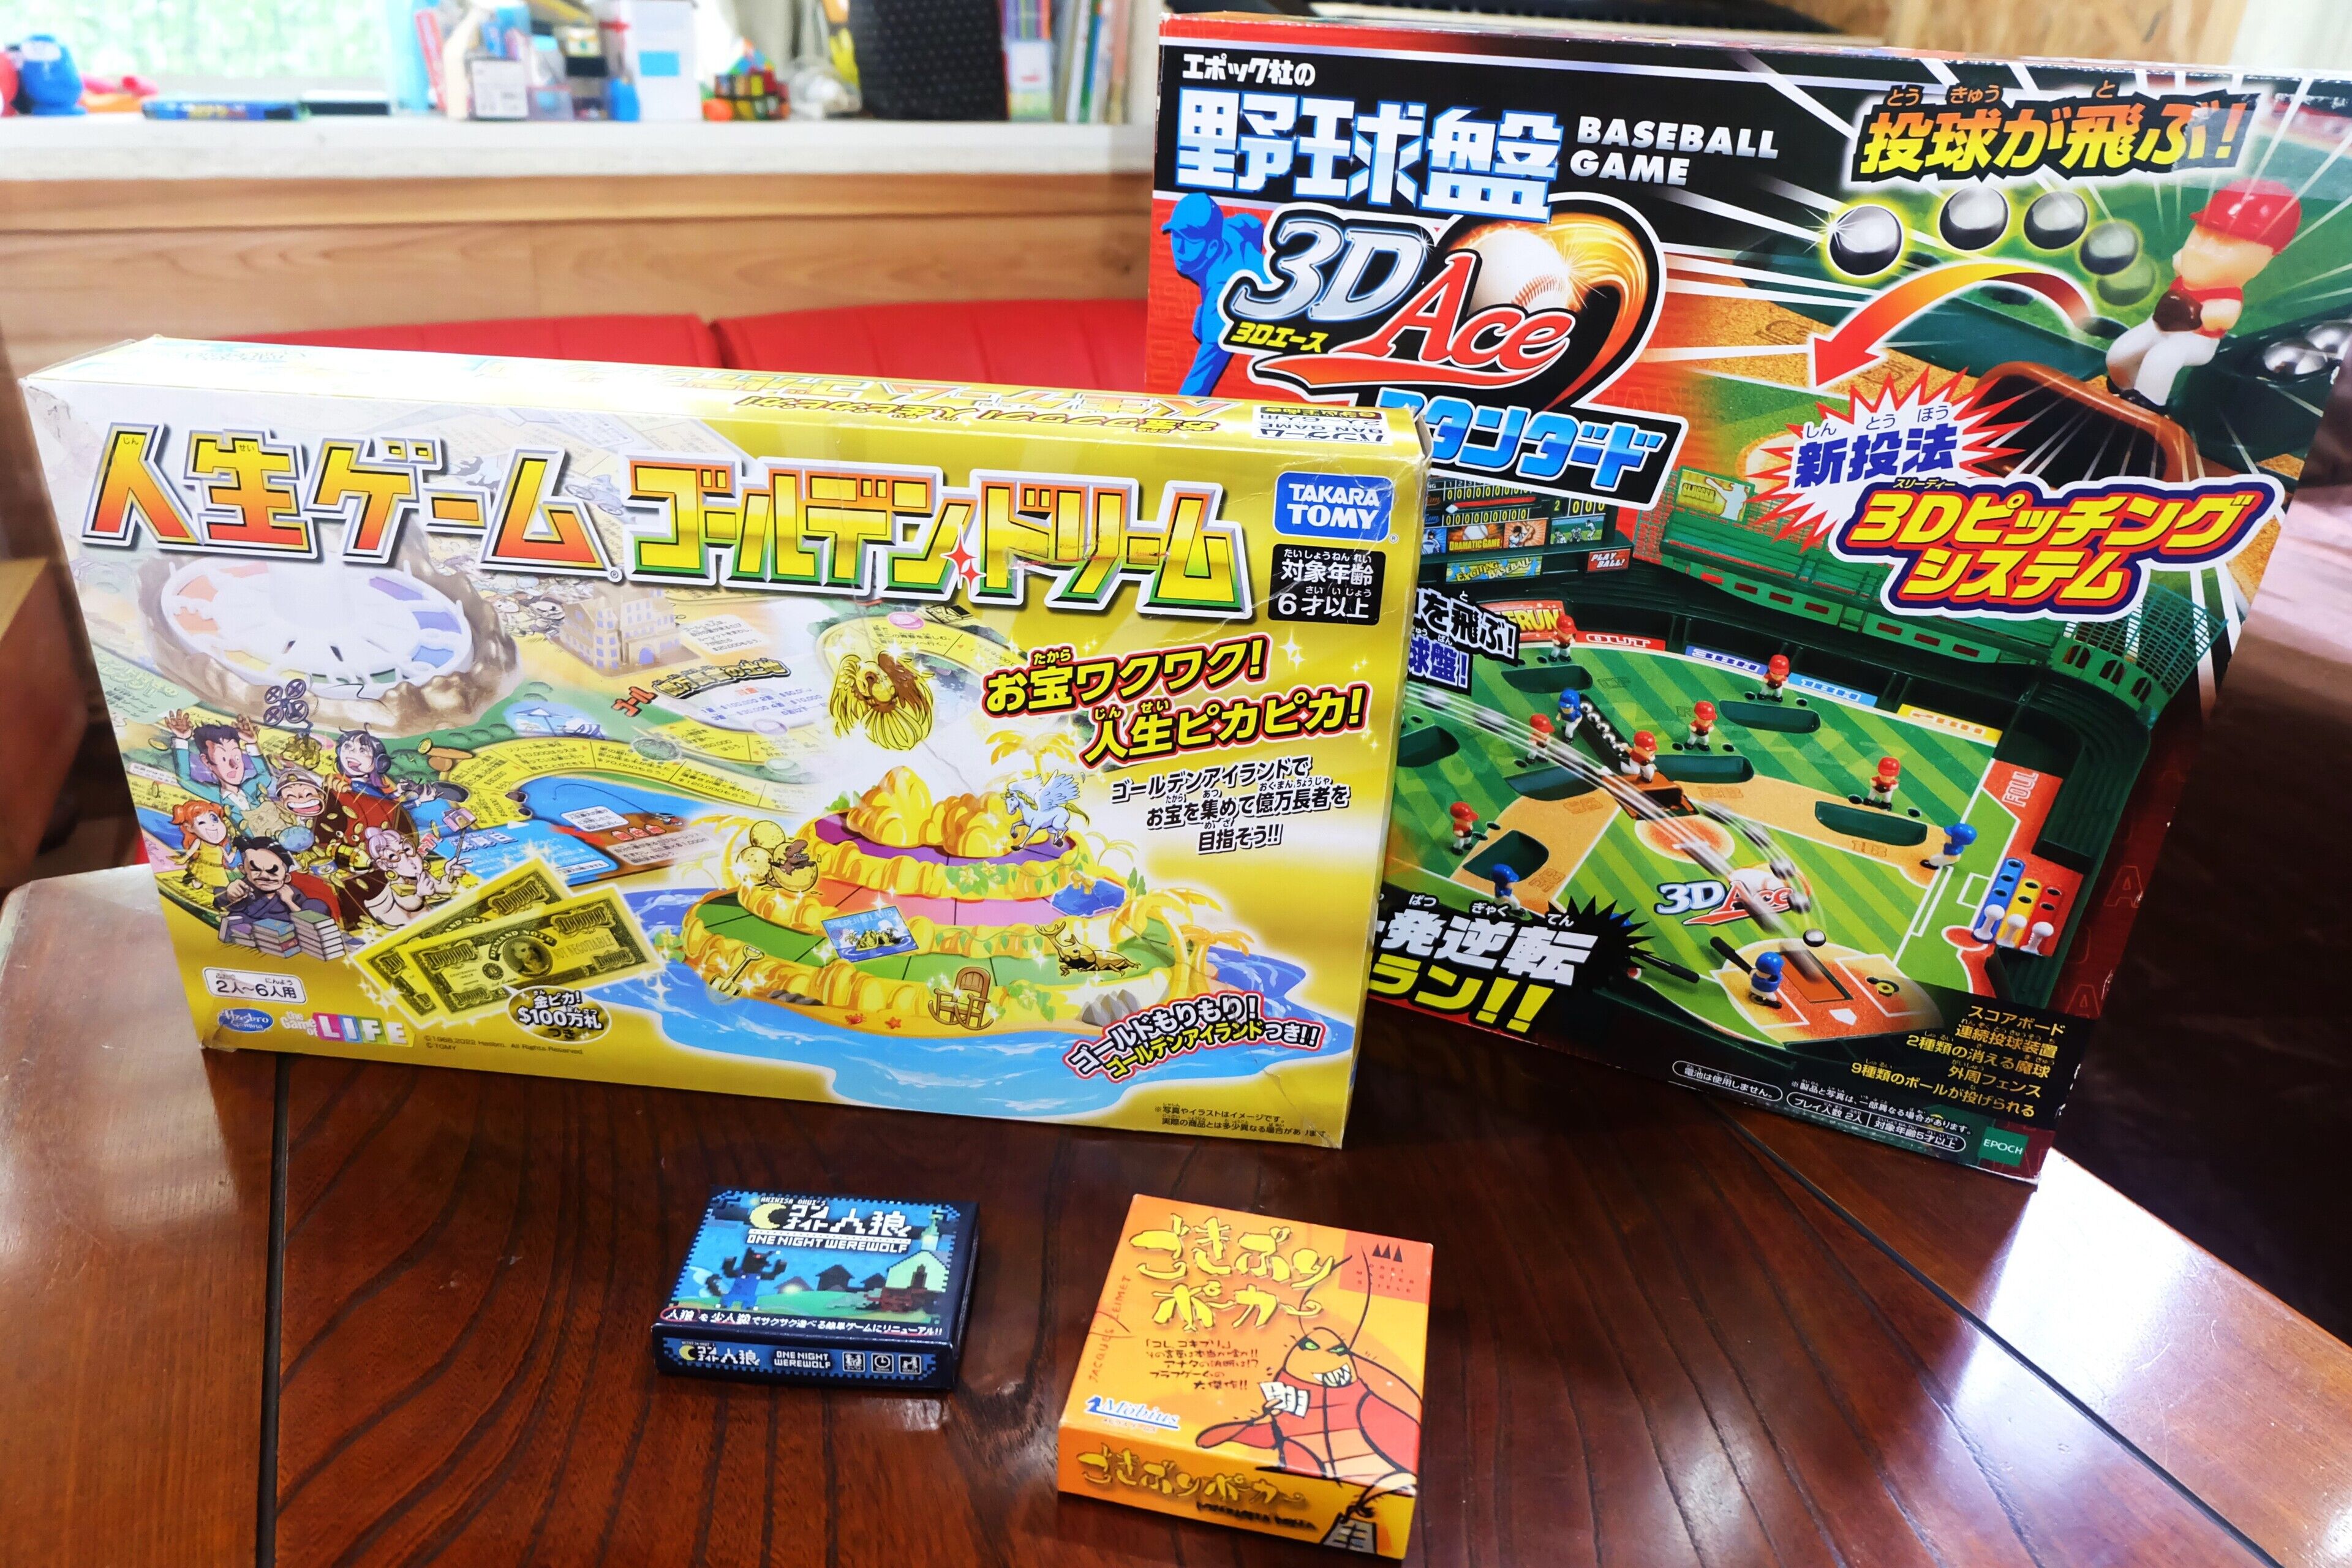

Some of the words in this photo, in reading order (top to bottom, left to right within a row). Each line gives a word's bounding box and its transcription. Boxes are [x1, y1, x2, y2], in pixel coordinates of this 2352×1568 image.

[1182, 53, 1316, 86] エポック社の
[1177, 87, 1564, 223] 野球盤
[1575, 116, 1779, 160] BASEBALL
[1860, 101, 2247, 174] 投球が飛ぶ!
[1569, 150, 1691, 186] GAME
[1230, 214, 1430, 322] 3D
[1338, 250, 1577, 372] Ace
[1231, 322, 1330, 353] 3Dエース
[1793, 423, 1958, 488] 新投法
[83, 420, 612, 573] 人生ゲーム
[1288, 483, 1380, 507] TAKARA
[1286, 503, 1379, 530] TOMY
[1849, 491, 2255, 549] 3Dピッチング
[1280, 558, 1374, 586] 対象年齢
[1591, 552, 1617, 562] PLAY
[1904, 550, 2127, 600] システム
[1277, 592, 1370, 619] 6才以上
[1586, 633, 1651, 648] OUT
[986, 639, 1266, 714] お宝ワクワク!
[1083, 687, 1367, 763] 人生ピカピカ!
[1111, 755, 1313, 802] ゴールデンアイランドで
[2001, 769, 2040, 809] FOUL
[1146, 785, 1350, 829] お宝を集めて億万長者を
[1198, 823, 1283, 855] 目指そう!!
[1654, 879, 1727, 915] 3D
[318, 1014, 408, 1044] LIFE
[1068, 993, 1260, 1074] ゴールドもりもり!
[1967, 1005, 2065, 1037] スコアボード
[1905, 1034, 2051, 1079] 2種類の消える魔球
[1954, 1024, 2058, 1059] 連続投球装置
[1850, 1060, 2035, 1118] 9種類のボールが投げられる
[1947, 1065, 2041, 1098] 外周フェンス
[1983, 1138, 2024, 1156] EPOCH
[746, 1234, 775, 1245] ONE
[776, 1235, 825, 1248] NIGHT
[824, 1238, 908, 1253] WEREWOLF
[774, 1358, 831, 1369] WEREWOLF
[776, 1350, 796, 1359] ONE
[796, 1351, 829, 1361] NIGHT
